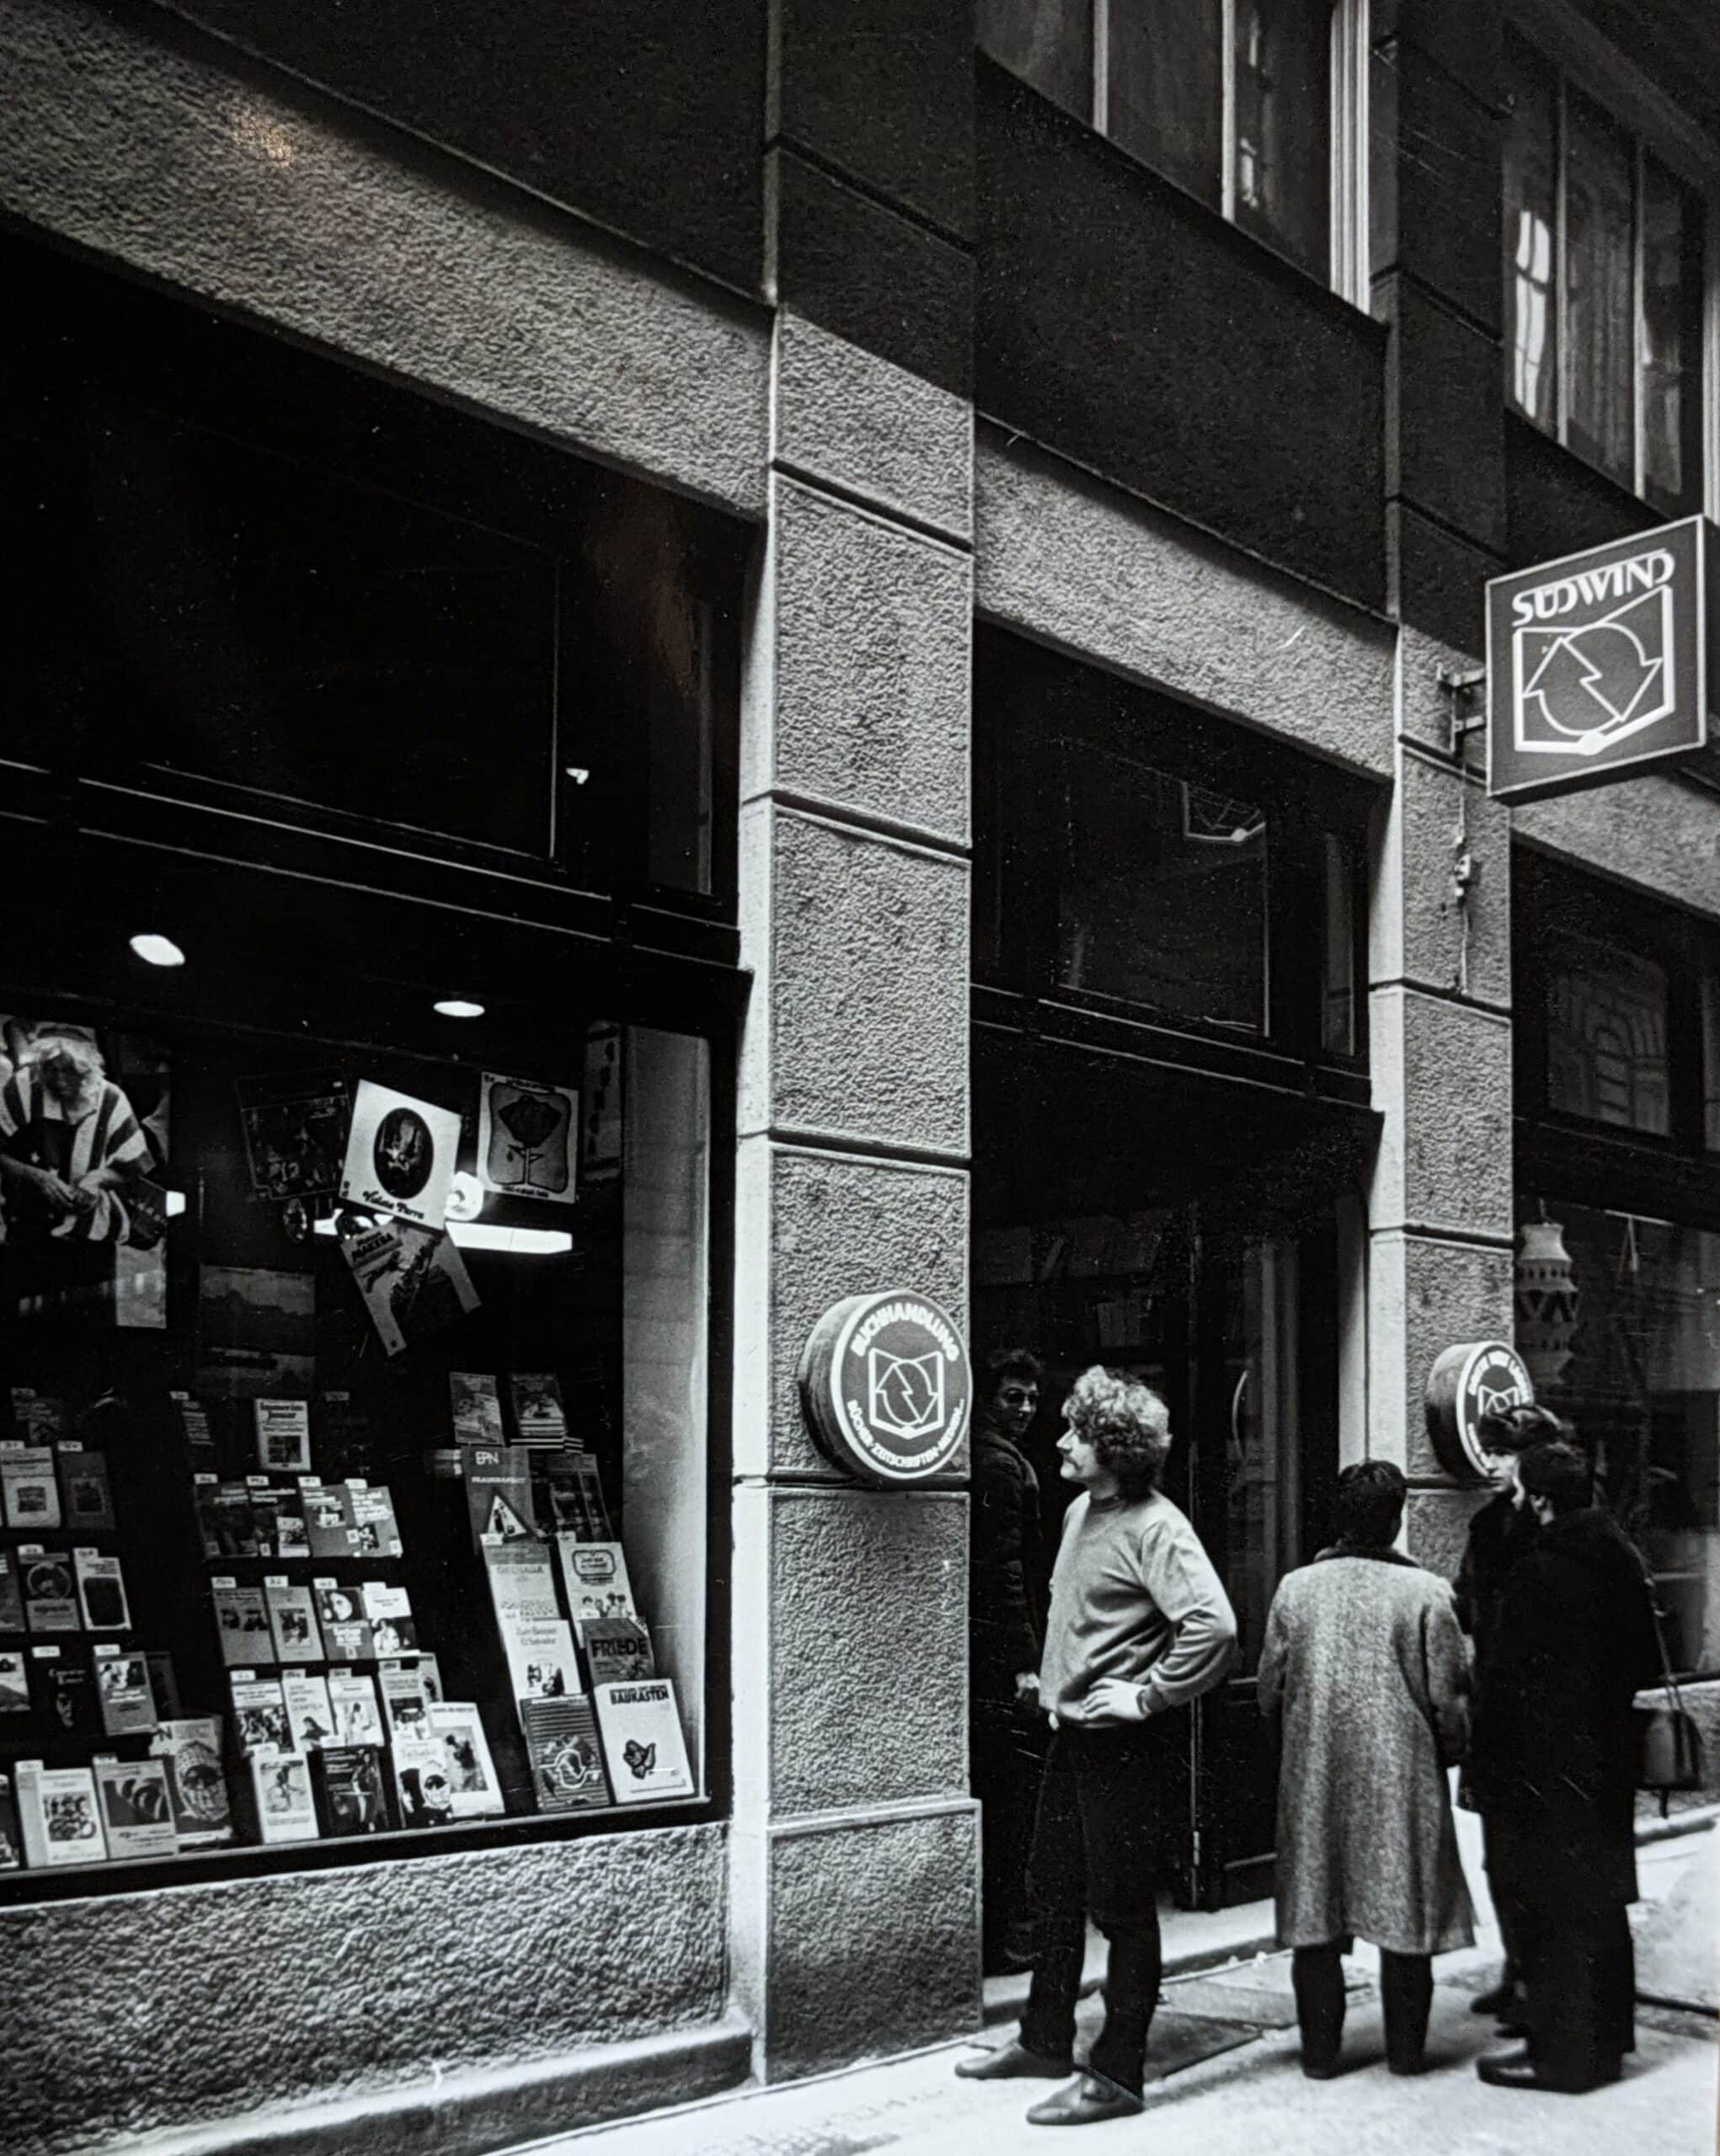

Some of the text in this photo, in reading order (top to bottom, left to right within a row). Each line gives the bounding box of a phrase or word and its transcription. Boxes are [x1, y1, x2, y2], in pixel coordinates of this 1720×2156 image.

[1512, 549, 1675, 627] SÜDWIND
[851, 1303, 959, 1361] BUCHHANDLUNG
[590, 1637, 649, 1657] FRIEDE
[611, 1687, 670, 1705] BAUKASTEN
